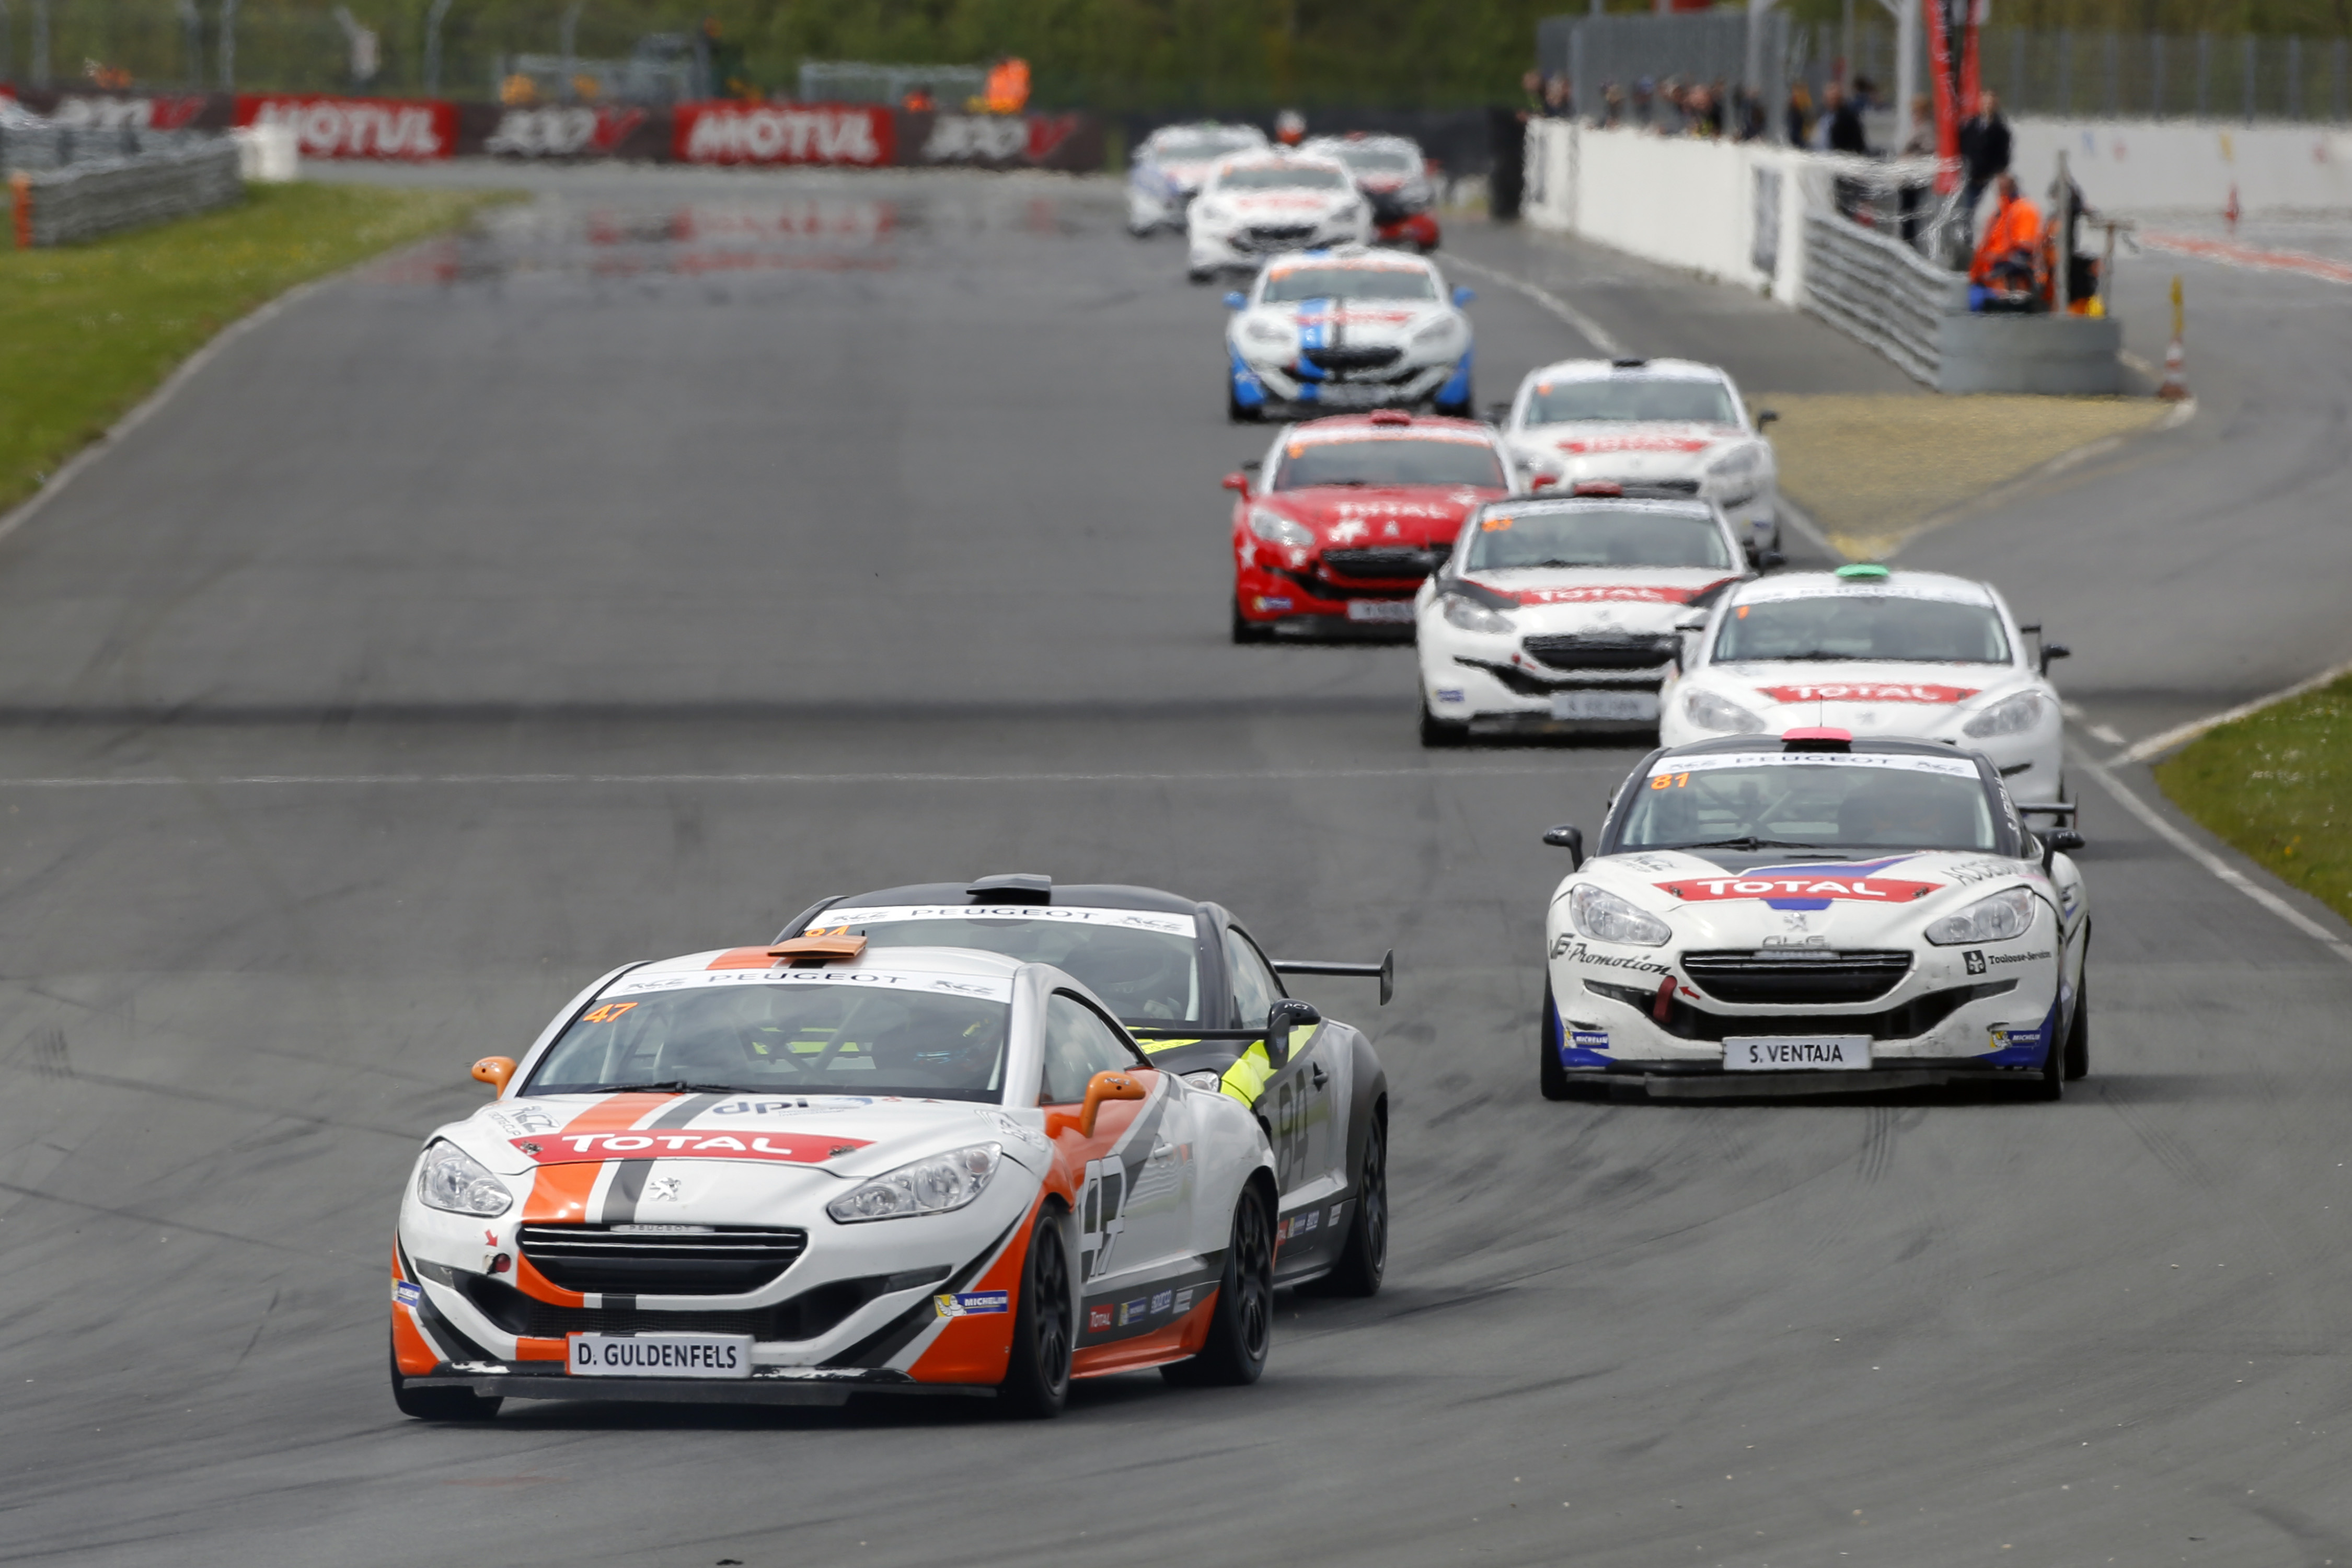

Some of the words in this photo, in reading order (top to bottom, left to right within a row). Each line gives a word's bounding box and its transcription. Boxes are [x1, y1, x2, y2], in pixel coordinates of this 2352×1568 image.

[683, 109, 882, 161] MOTUL
[1531, 589, 1665, 602] TOTAL
[1788, 686, 1941, 699] TOTAL
[1736, 755, 1895, 764] PEUGEOT
[1651, 773, 1690, 790] 81
[1697, 880, 1886, 896] TOTAL
[912, 908, 1100, 919] PEUGEOT
[708, 973, 907, 984] PEUGEOT
[583, 1001, 639, 1023] 47
[1749, 1045, 1763, 1063] S.
[1767, 1044, 1843, 1062] VENTAJA
[562, 1133, 792, 1155] TOTAL
[964, 1297, 1007, 1306] MICHELIN
[578, 1343, 597, 1366] D.
[604, 1344, 737, 1369] GULDENFELS
